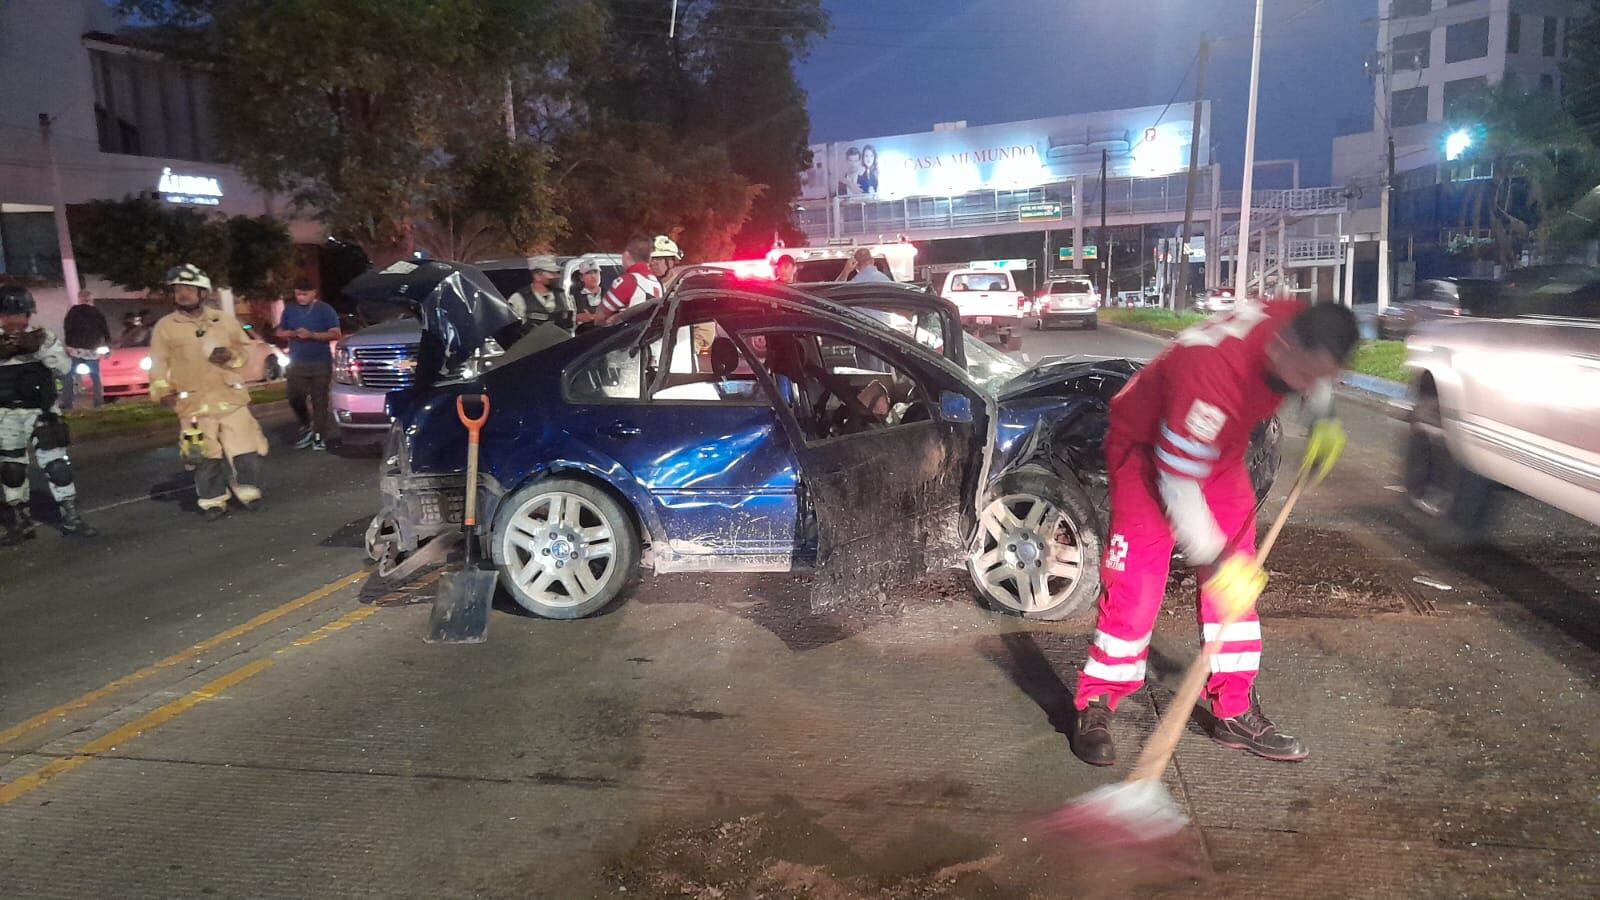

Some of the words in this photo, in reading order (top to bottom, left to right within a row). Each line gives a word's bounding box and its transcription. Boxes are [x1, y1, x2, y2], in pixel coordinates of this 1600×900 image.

[904, 155, 942, 170] CASA
[951, 151, 969, 165] MI
[974, 144, 1036, 164] MUNDO
